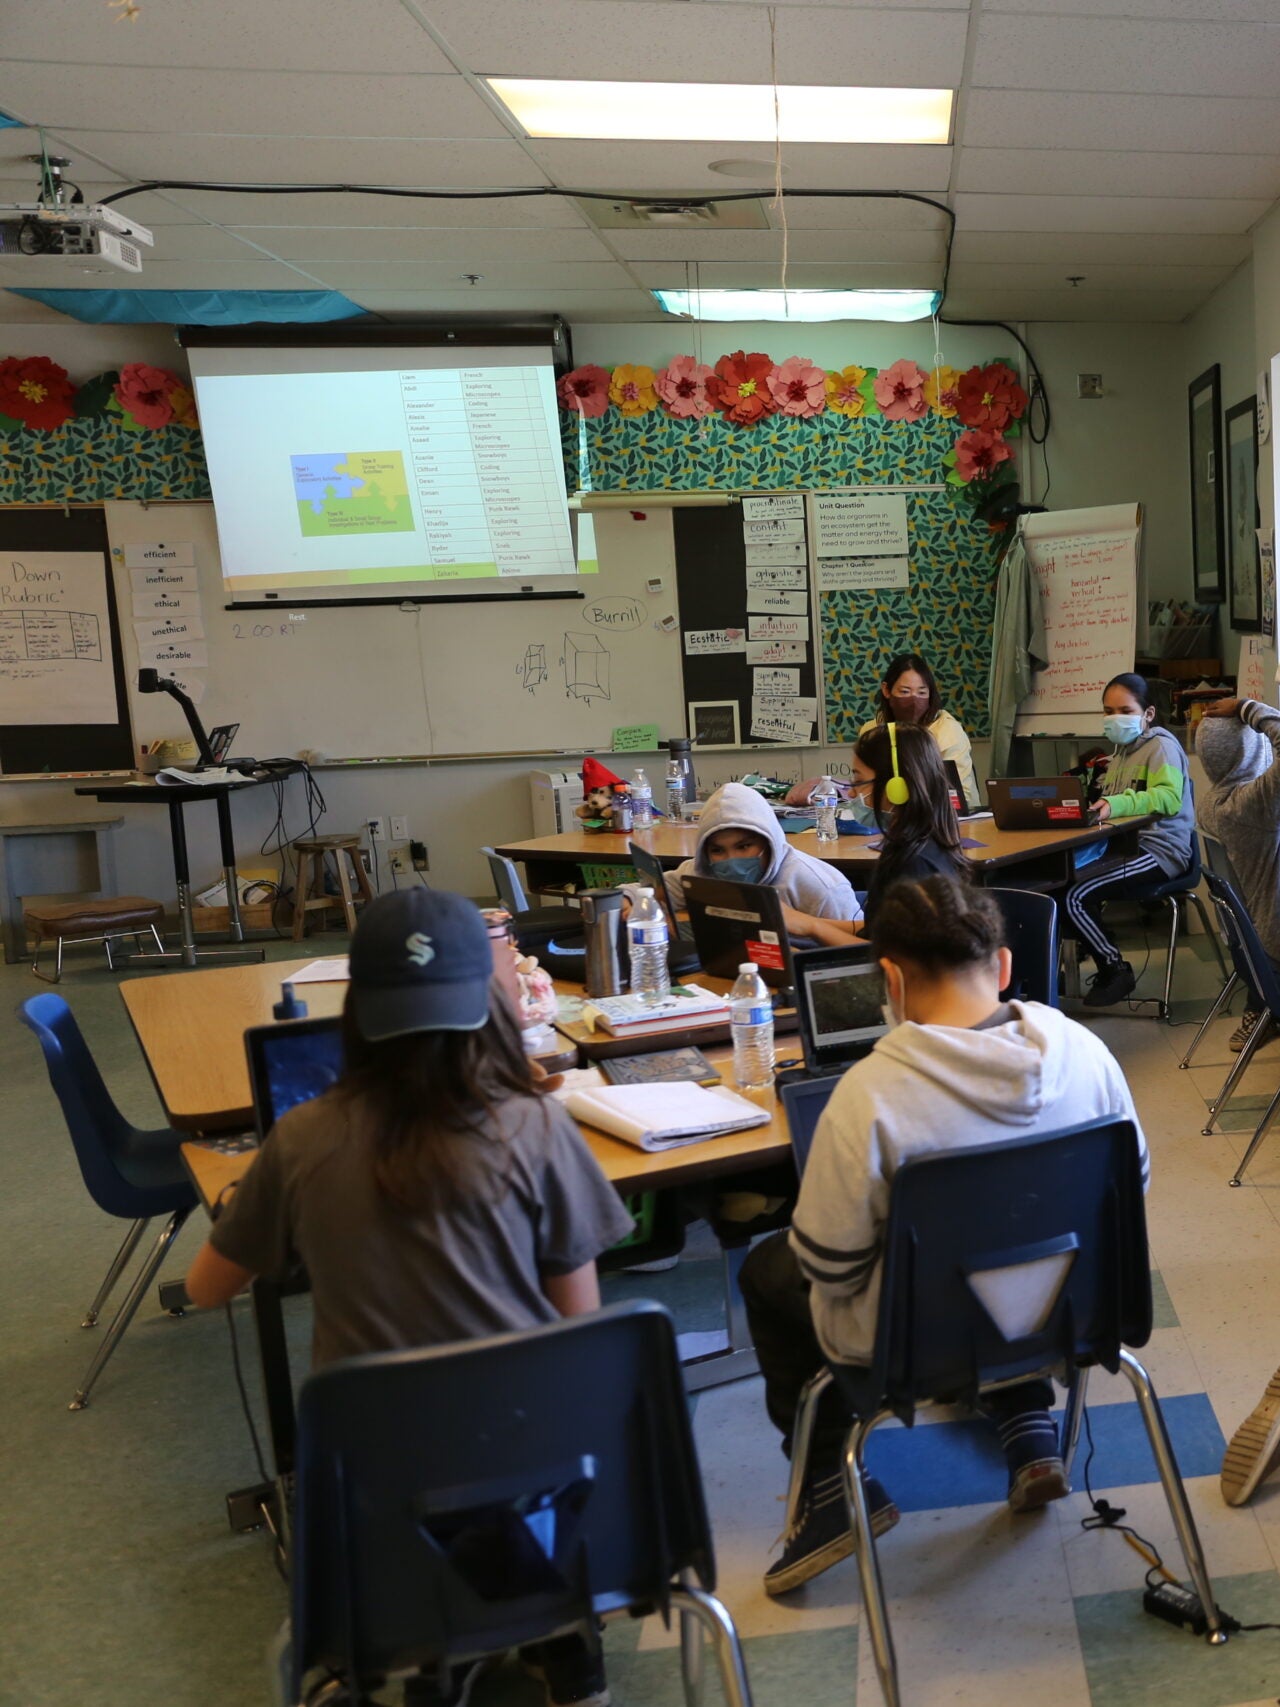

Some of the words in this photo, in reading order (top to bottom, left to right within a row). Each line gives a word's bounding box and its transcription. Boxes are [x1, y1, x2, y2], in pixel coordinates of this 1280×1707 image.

[475, 434, 501, 442] Exploring
[750, 497, 799, 512] procrastinate
[831, 522, 866, 530] ecosystem
[144, 551, 177, 559] efficient
[11, 561, 61, 583] Down
[1034, 556, 1056, 578] night
[146, 576, 184, 584] inefficient
[1072, 576, 1099, 588] horizontal
[1071, 586, 1095, 598] vertical
[154, 600, 180, 608] ethical
[765, 598, 791, 606] reliable
[152, 625, 187, 636] unethical
[760, 620, 798, 630] intuition
[690, 632, 730, 645] Ecstatic
[156, 652, 191, 660] desirable
[764, 646, 786, 657] adapt
[758, 718, 796, 732] resentful
